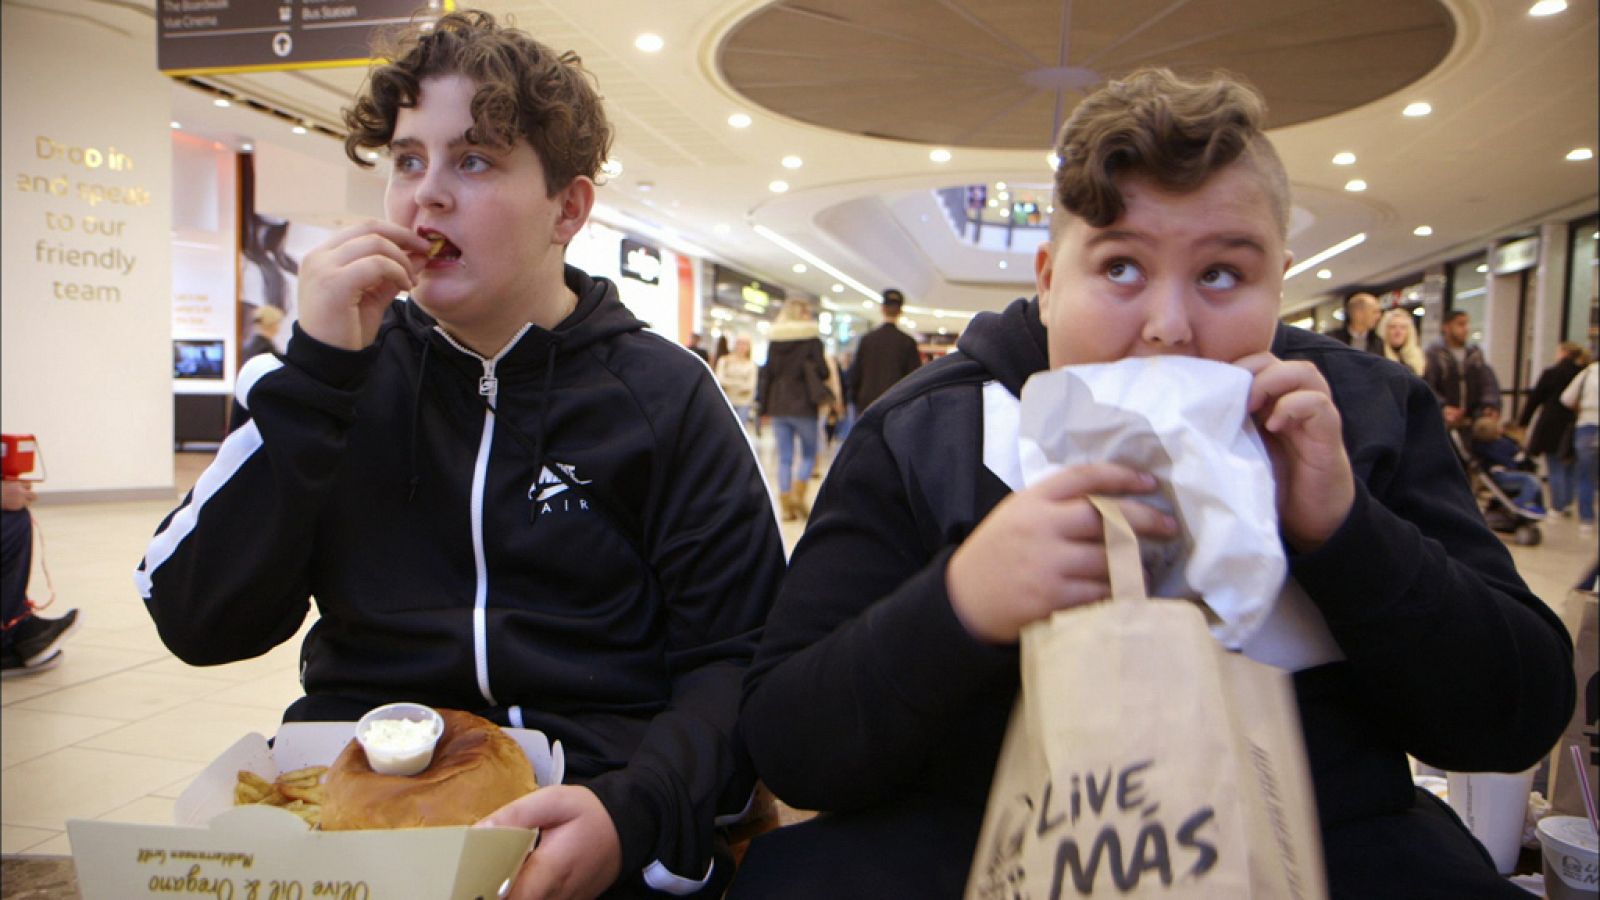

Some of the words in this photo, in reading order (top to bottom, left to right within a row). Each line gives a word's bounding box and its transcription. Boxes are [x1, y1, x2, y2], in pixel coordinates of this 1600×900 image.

[108, 145, 134, 172] in
[16, 172, 69, 197] and
[45, 211, 75, 232] to
[82, 216, 127, 237] our
[35, 239, 137, 276] friendly
[53, 280, 121, 303] team
[541, 499, 590, 514] AIR
[148, 864, 236, 900] Oregano
[244, 879, 261, 900] &
[269, 880, 304, 900] Oil
[311, 880, 370, 900] Olive
